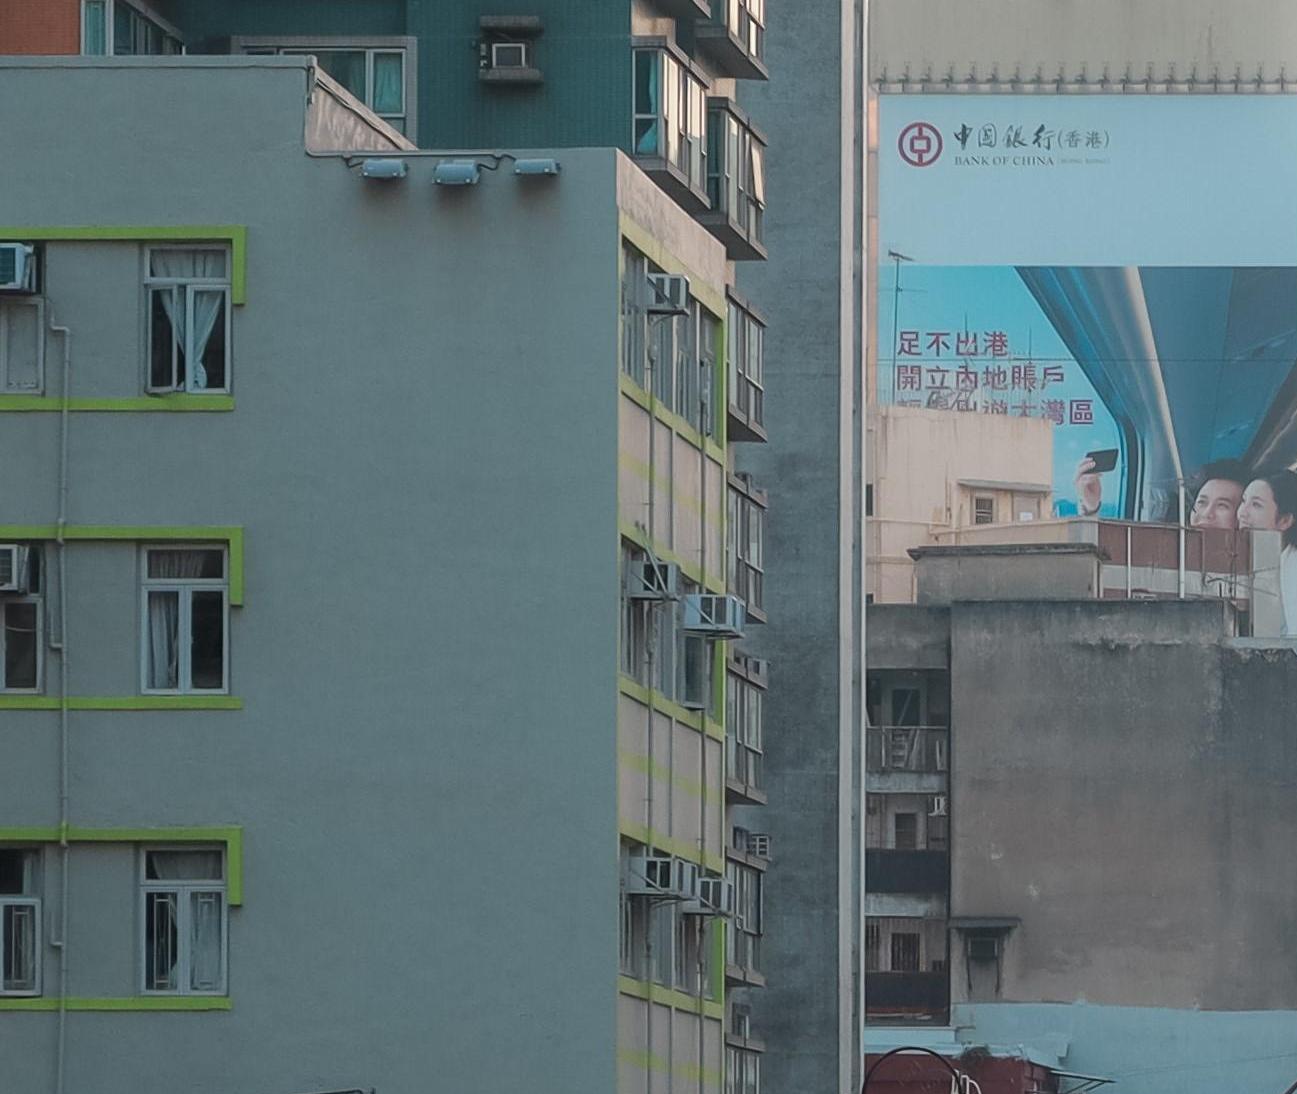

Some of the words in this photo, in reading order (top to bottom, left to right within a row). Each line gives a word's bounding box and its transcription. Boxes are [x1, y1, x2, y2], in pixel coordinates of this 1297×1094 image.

[954, 156, 989, 166] BANK
[992, 156, 1009, 166] OF
[1012, 156, 1054, 166] CHINA
[897, 331, 1008, 357] 足不出港
